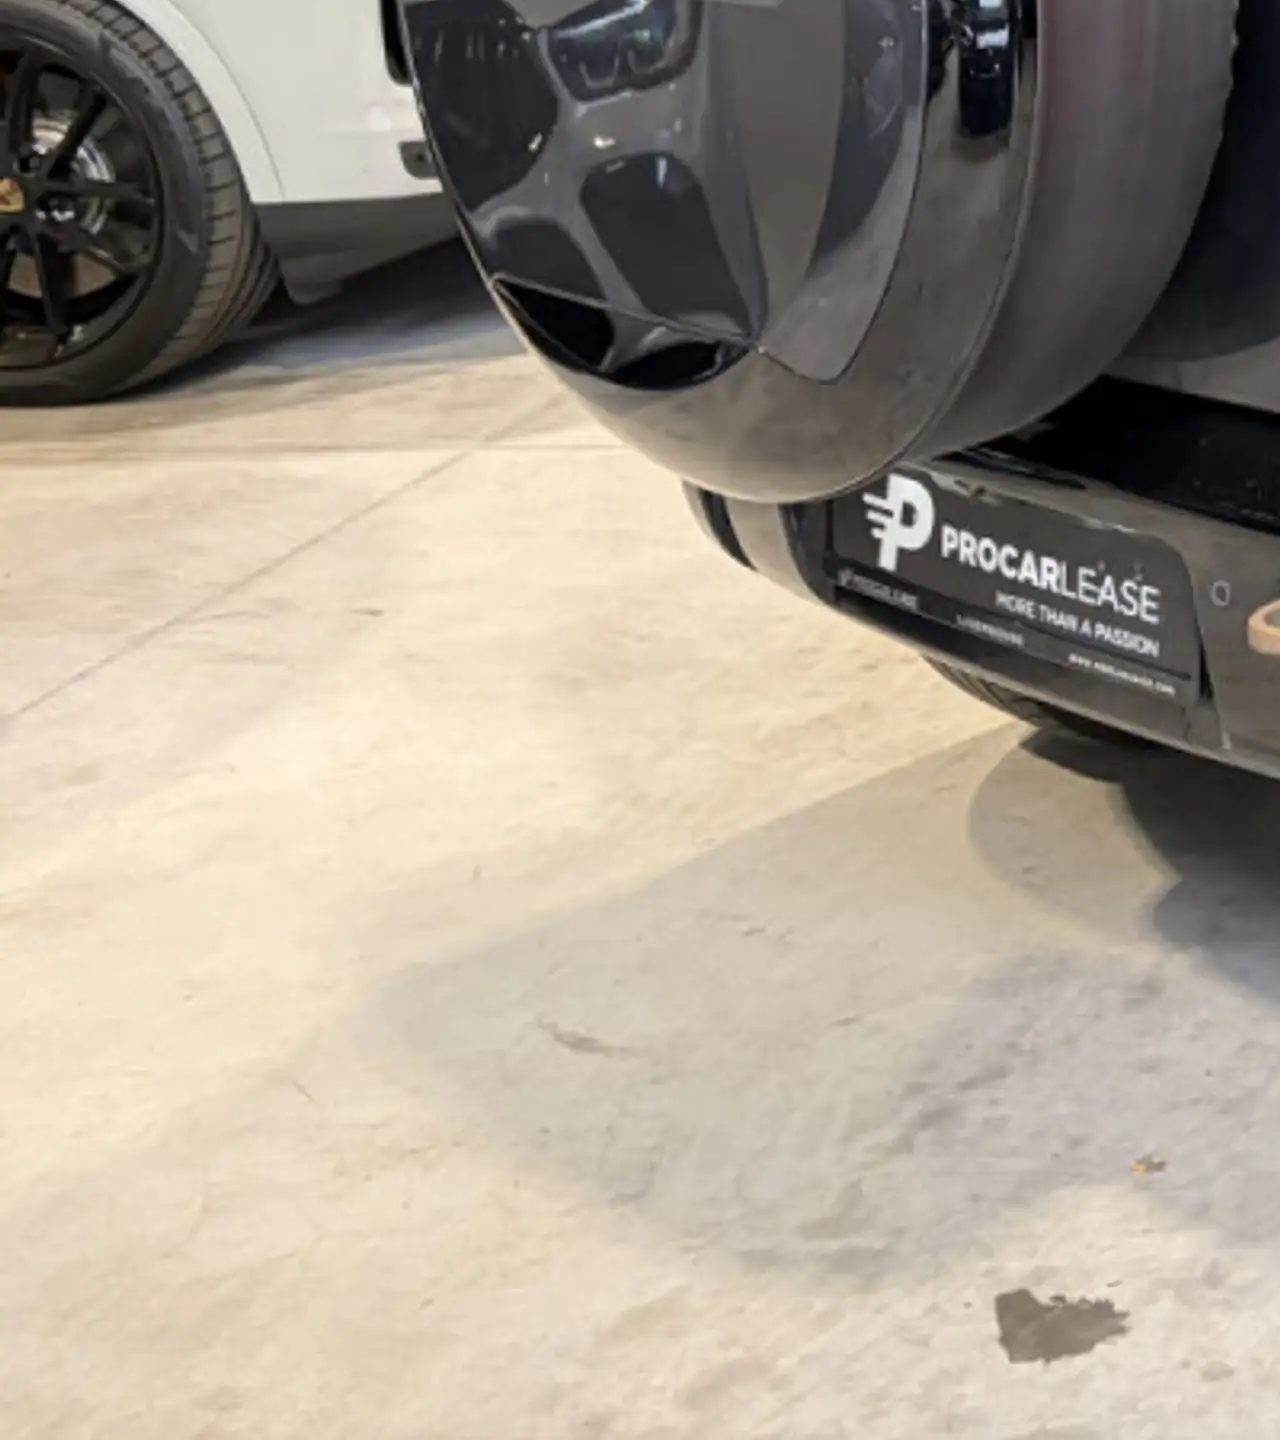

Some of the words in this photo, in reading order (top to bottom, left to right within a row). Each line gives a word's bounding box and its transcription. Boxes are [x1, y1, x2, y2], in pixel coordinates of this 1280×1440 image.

[940, 523, 1162, 625] PROCARLEASE
[995, 590, 1036, 620] MORE
[1039, 604, 1079, 633] THAN
[1079, 618, 1093, 637] A
[1094, 621, 1161, 657] PASSION
